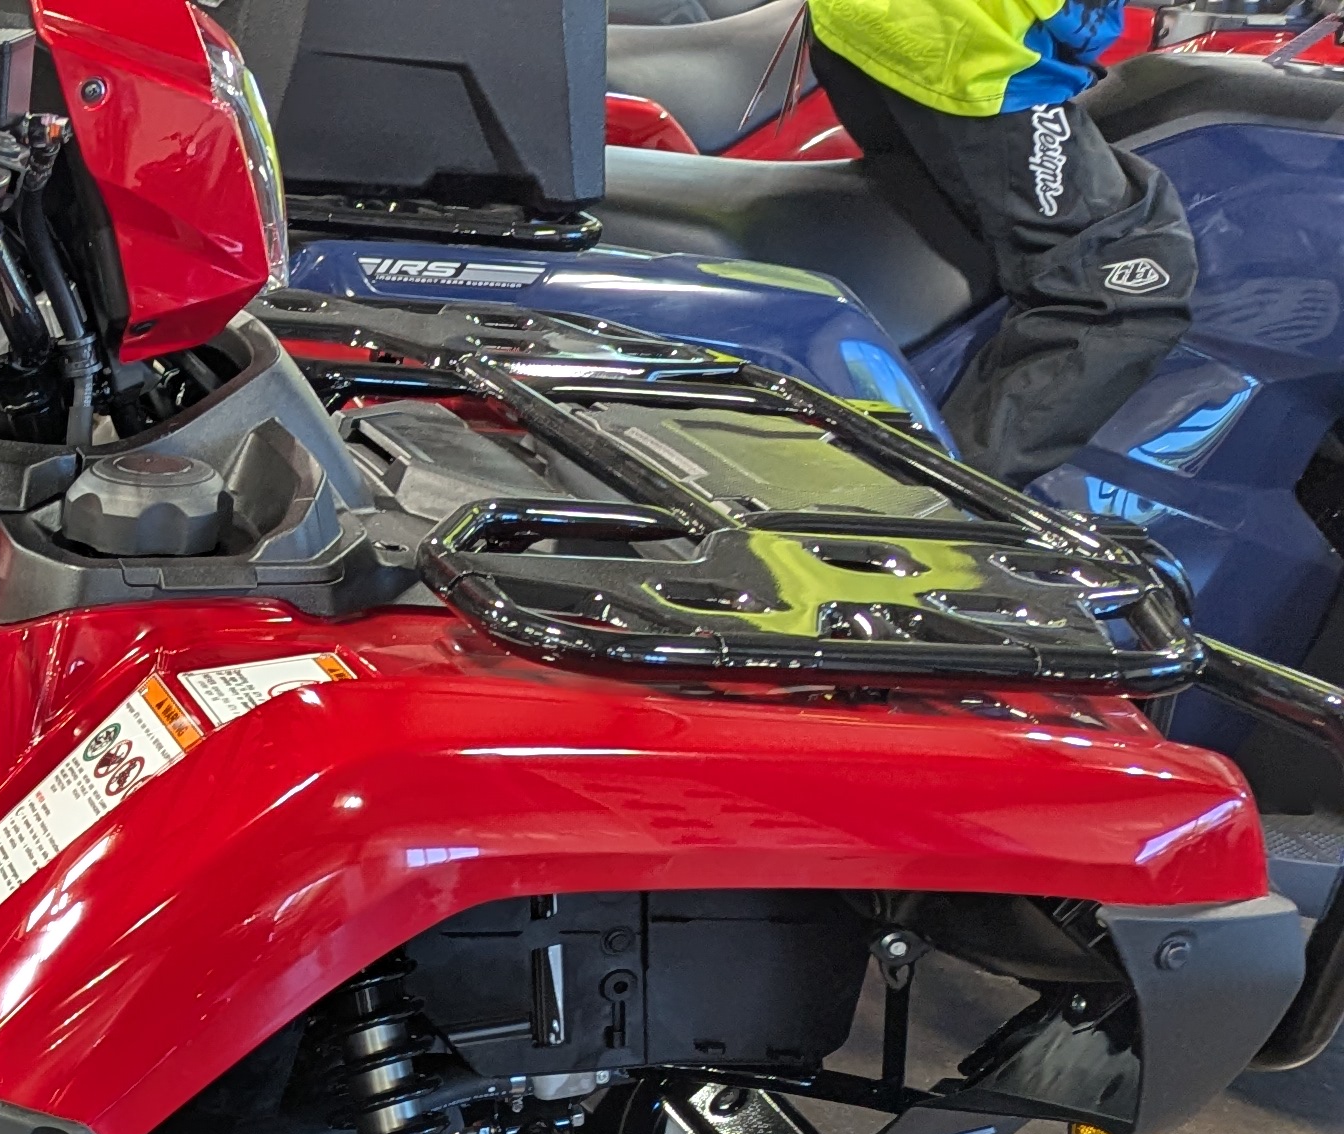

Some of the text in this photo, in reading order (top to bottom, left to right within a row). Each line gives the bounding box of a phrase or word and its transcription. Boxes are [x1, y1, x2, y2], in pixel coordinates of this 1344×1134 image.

[1029, 106, 1071, 216] Designs
[376, 259, 461, 277] IRS
[466, 281, 522, 289] SUSPENSION
